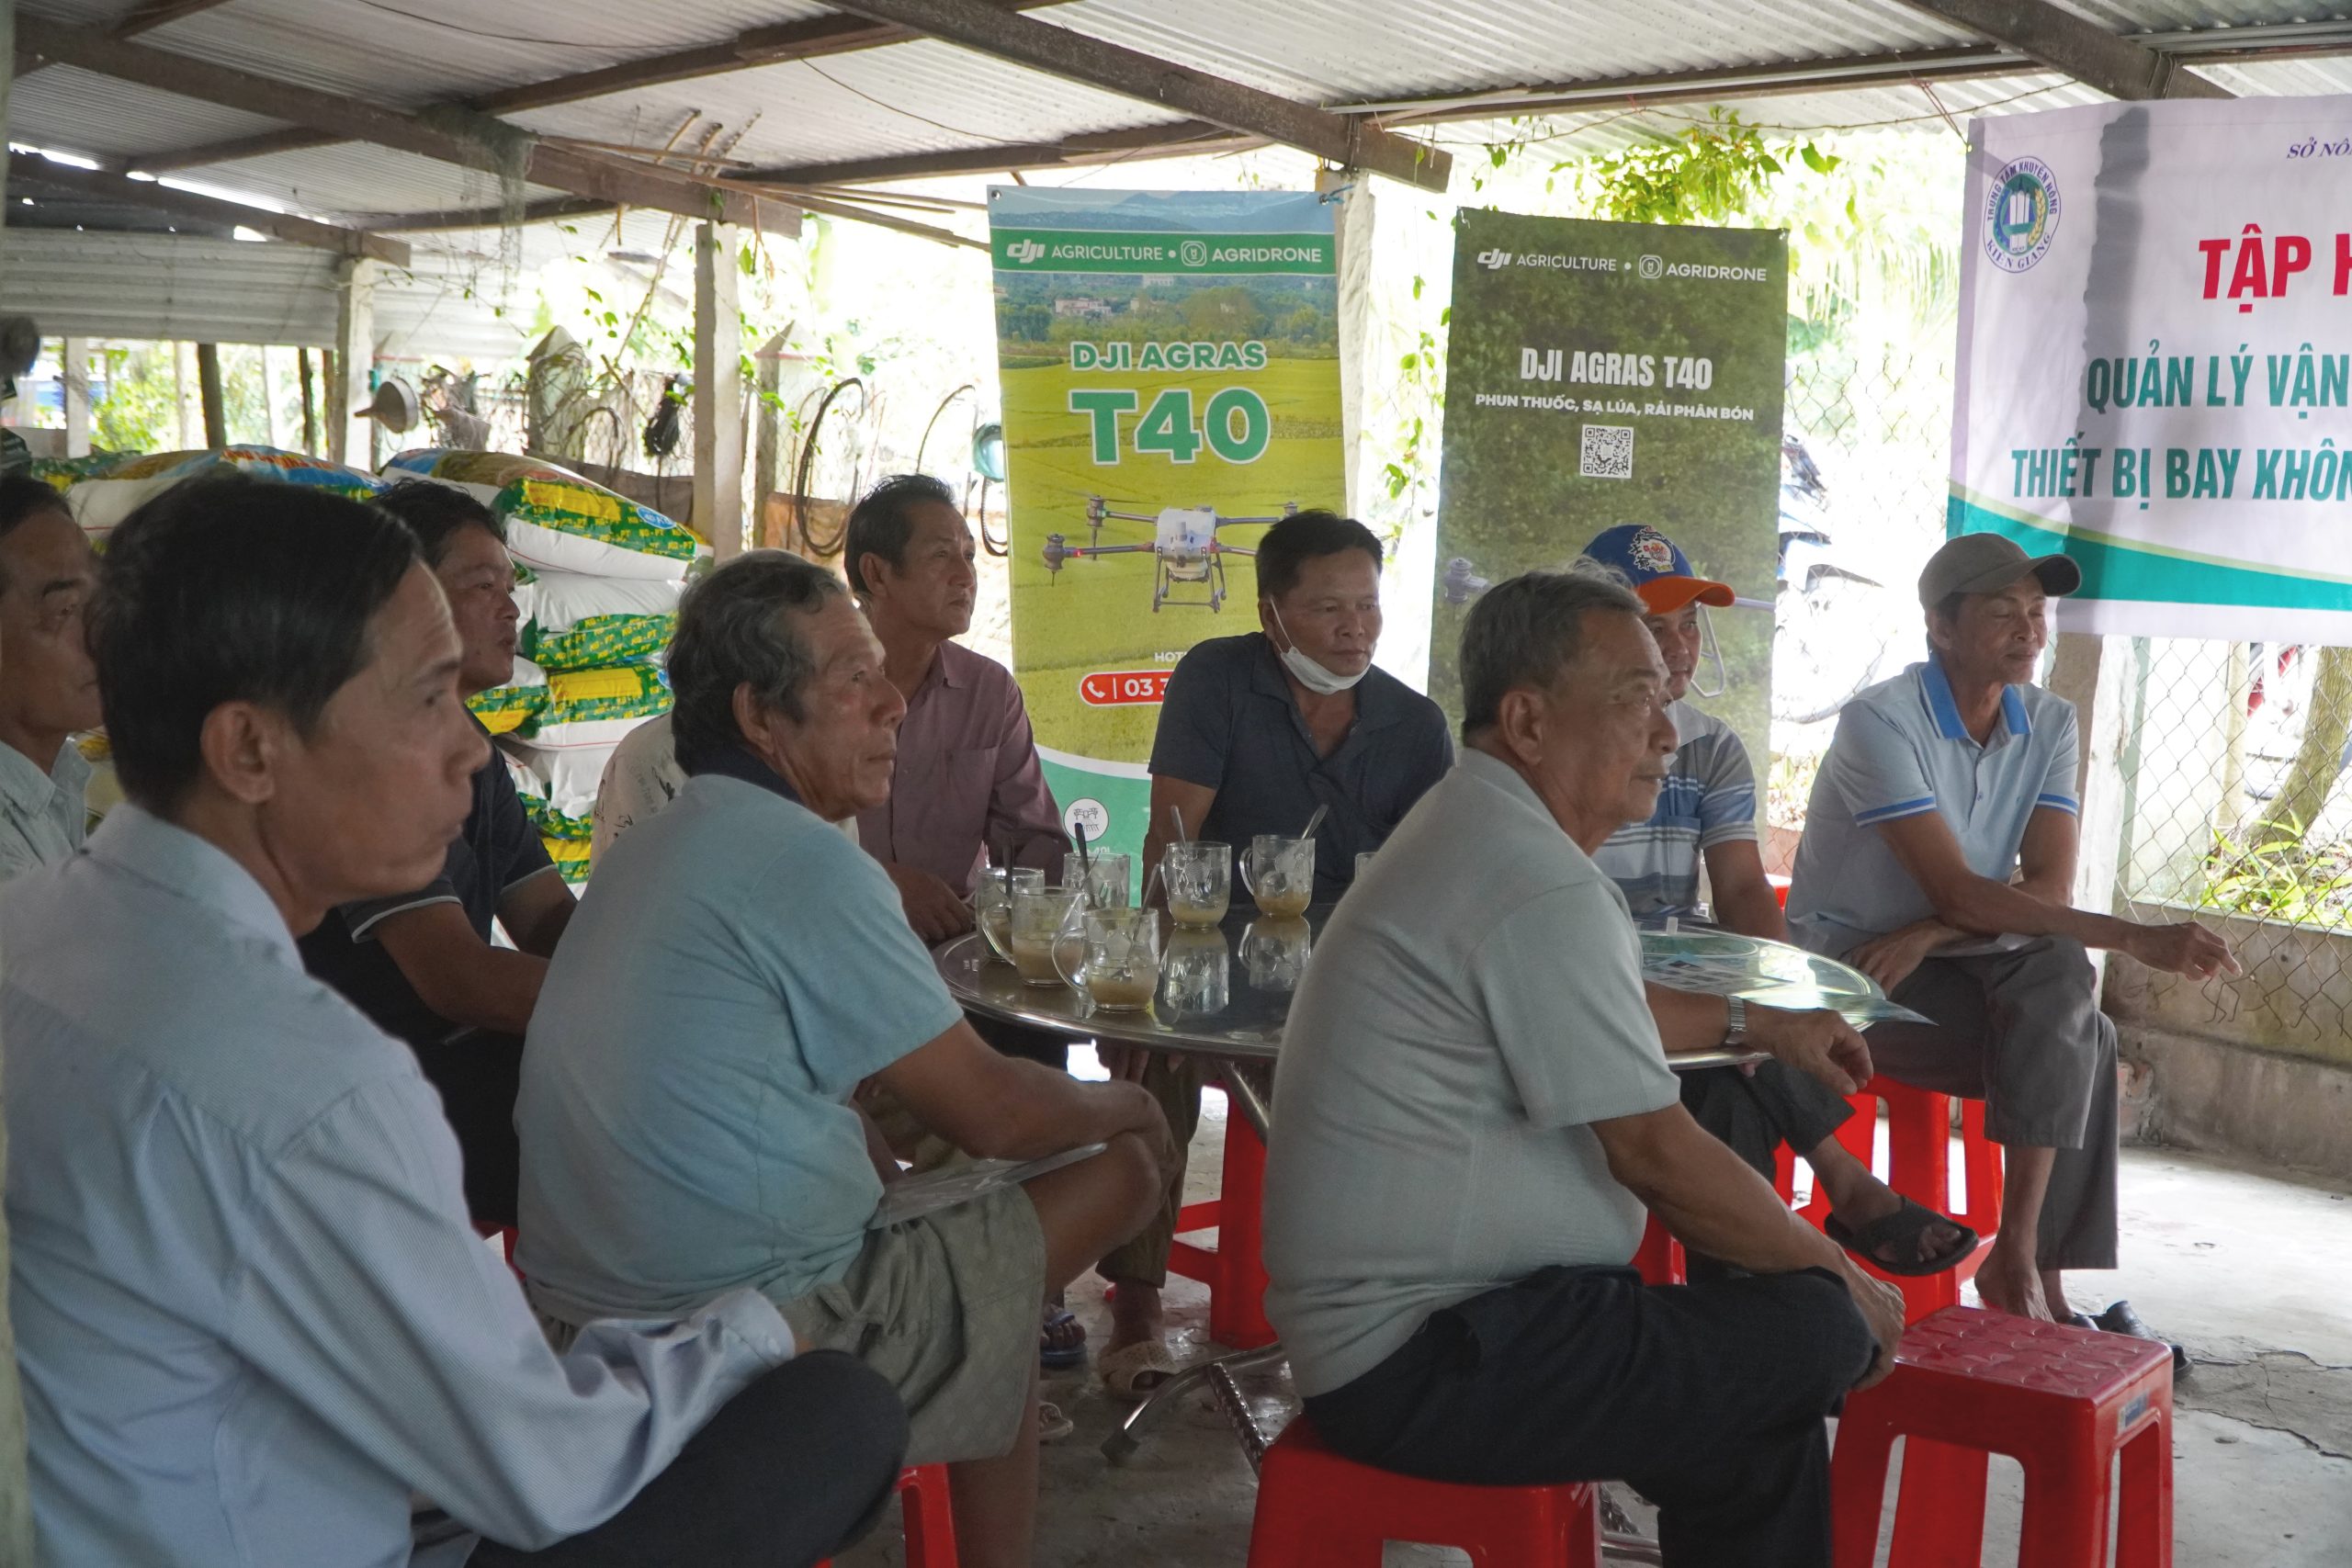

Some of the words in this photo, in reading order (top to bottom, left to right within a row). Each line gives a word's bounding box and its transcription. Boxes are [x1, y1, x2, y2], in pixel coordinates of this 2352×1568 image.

[2287, 137, 2317, 159] SỞ
[2318, 138, 2352, 158] NÔ
[1987, 184, 2003, 221] TRUNG
[1051, 244, 1164, 261] AGRICULTURE
[1212, 247, 1323, 263] AGRIDRONE
[2018, 231, 2050, 269] GIANG
[1516, 254, 1618, 272] AGRICULTURE
[1666, 263, 1768, 282] AGRIDRONE
[2199, 223, 2312, 313] TẬP
[1070, 342, 1133, 371] DJI
[1137, 341, 1268, 371] AGRAS
[1521, 347, 1564, 382] DJI
[1569, 351, 1656, 388] AGRAS
[1663, 355, 1713, 390] T40
[2086, 338, 2195, 415] QUẢN
[2207, 344, 2254, 407] LÝ
[2267, 343, 2350, 419] VẬN
[1475, 393, 1519, 407] PHUN
[1521, 394, 1579, 412] THUỐC,
[1582, 399, 1604, 415] SẠ
[1606, 399, 1642, 416] LÚA,
[1645, 400, 1671, 416] RẢI
[1674, 403, 1718, 419] PHÂN
[1720, 405, 1754, 421] BÓN
[1069, 386, 1272, 465] T40
[2011, 431, 2102, 498] THIẾT
[2112, 447, 2152, 510] BỊ
[2166, 447, 2243, 499] BAY
[1154, 650, 1188, 662] HOT
[1124, 678, 1154, 697] 03
